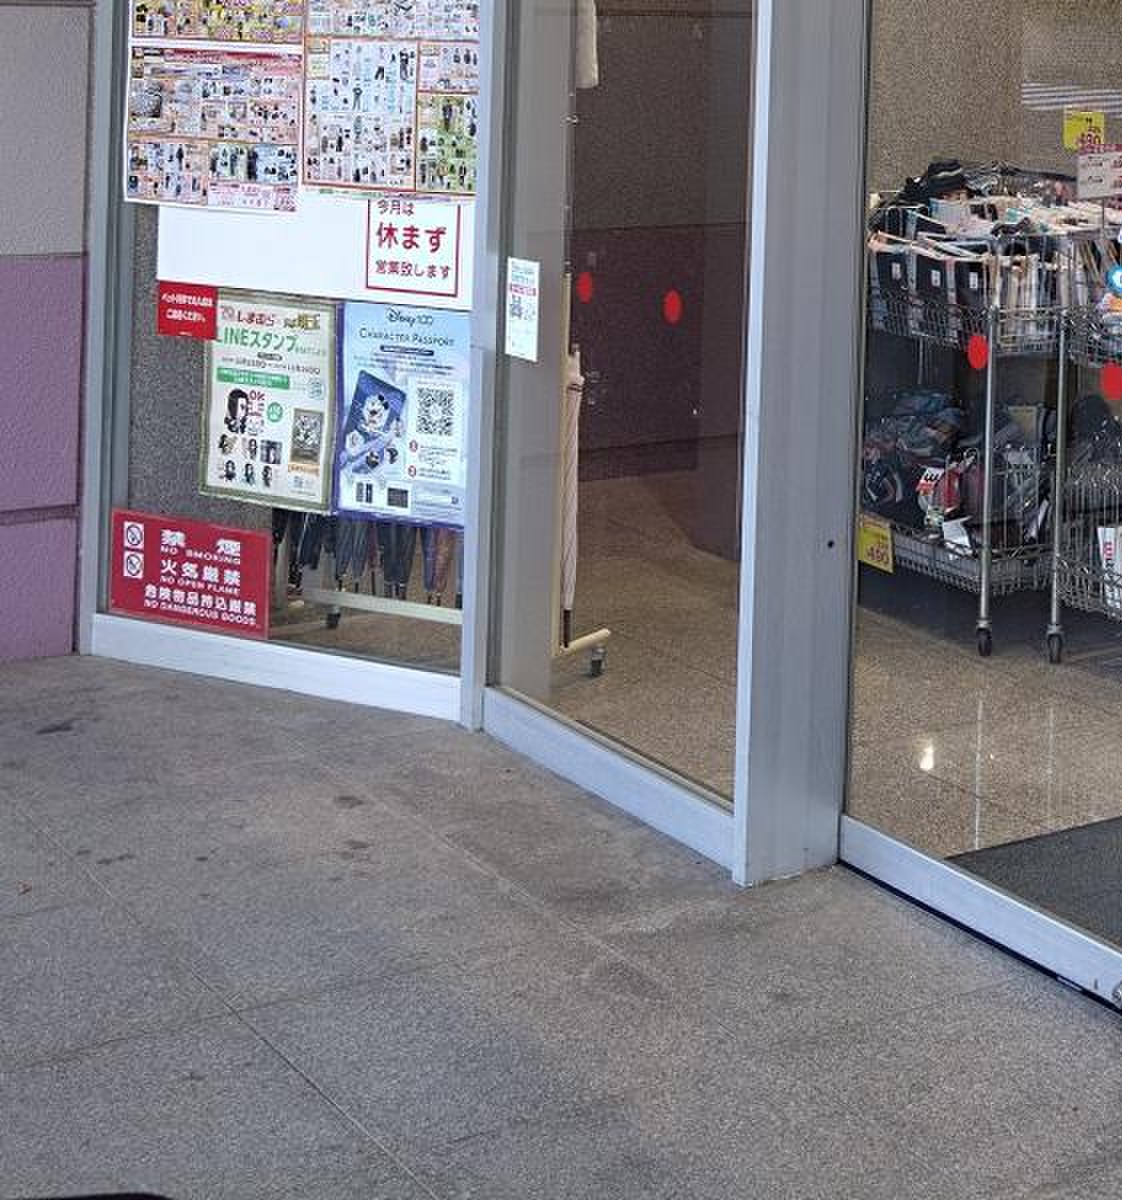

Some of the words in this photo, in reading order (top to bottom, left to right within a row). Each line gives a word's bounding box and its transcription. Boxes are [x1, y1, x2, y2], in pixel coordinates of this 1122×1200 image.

[376, 221, 448, 253] 休まず
[160, 545, 178, 555] NO
[160, 559, 241, 587] 火気厳禁
